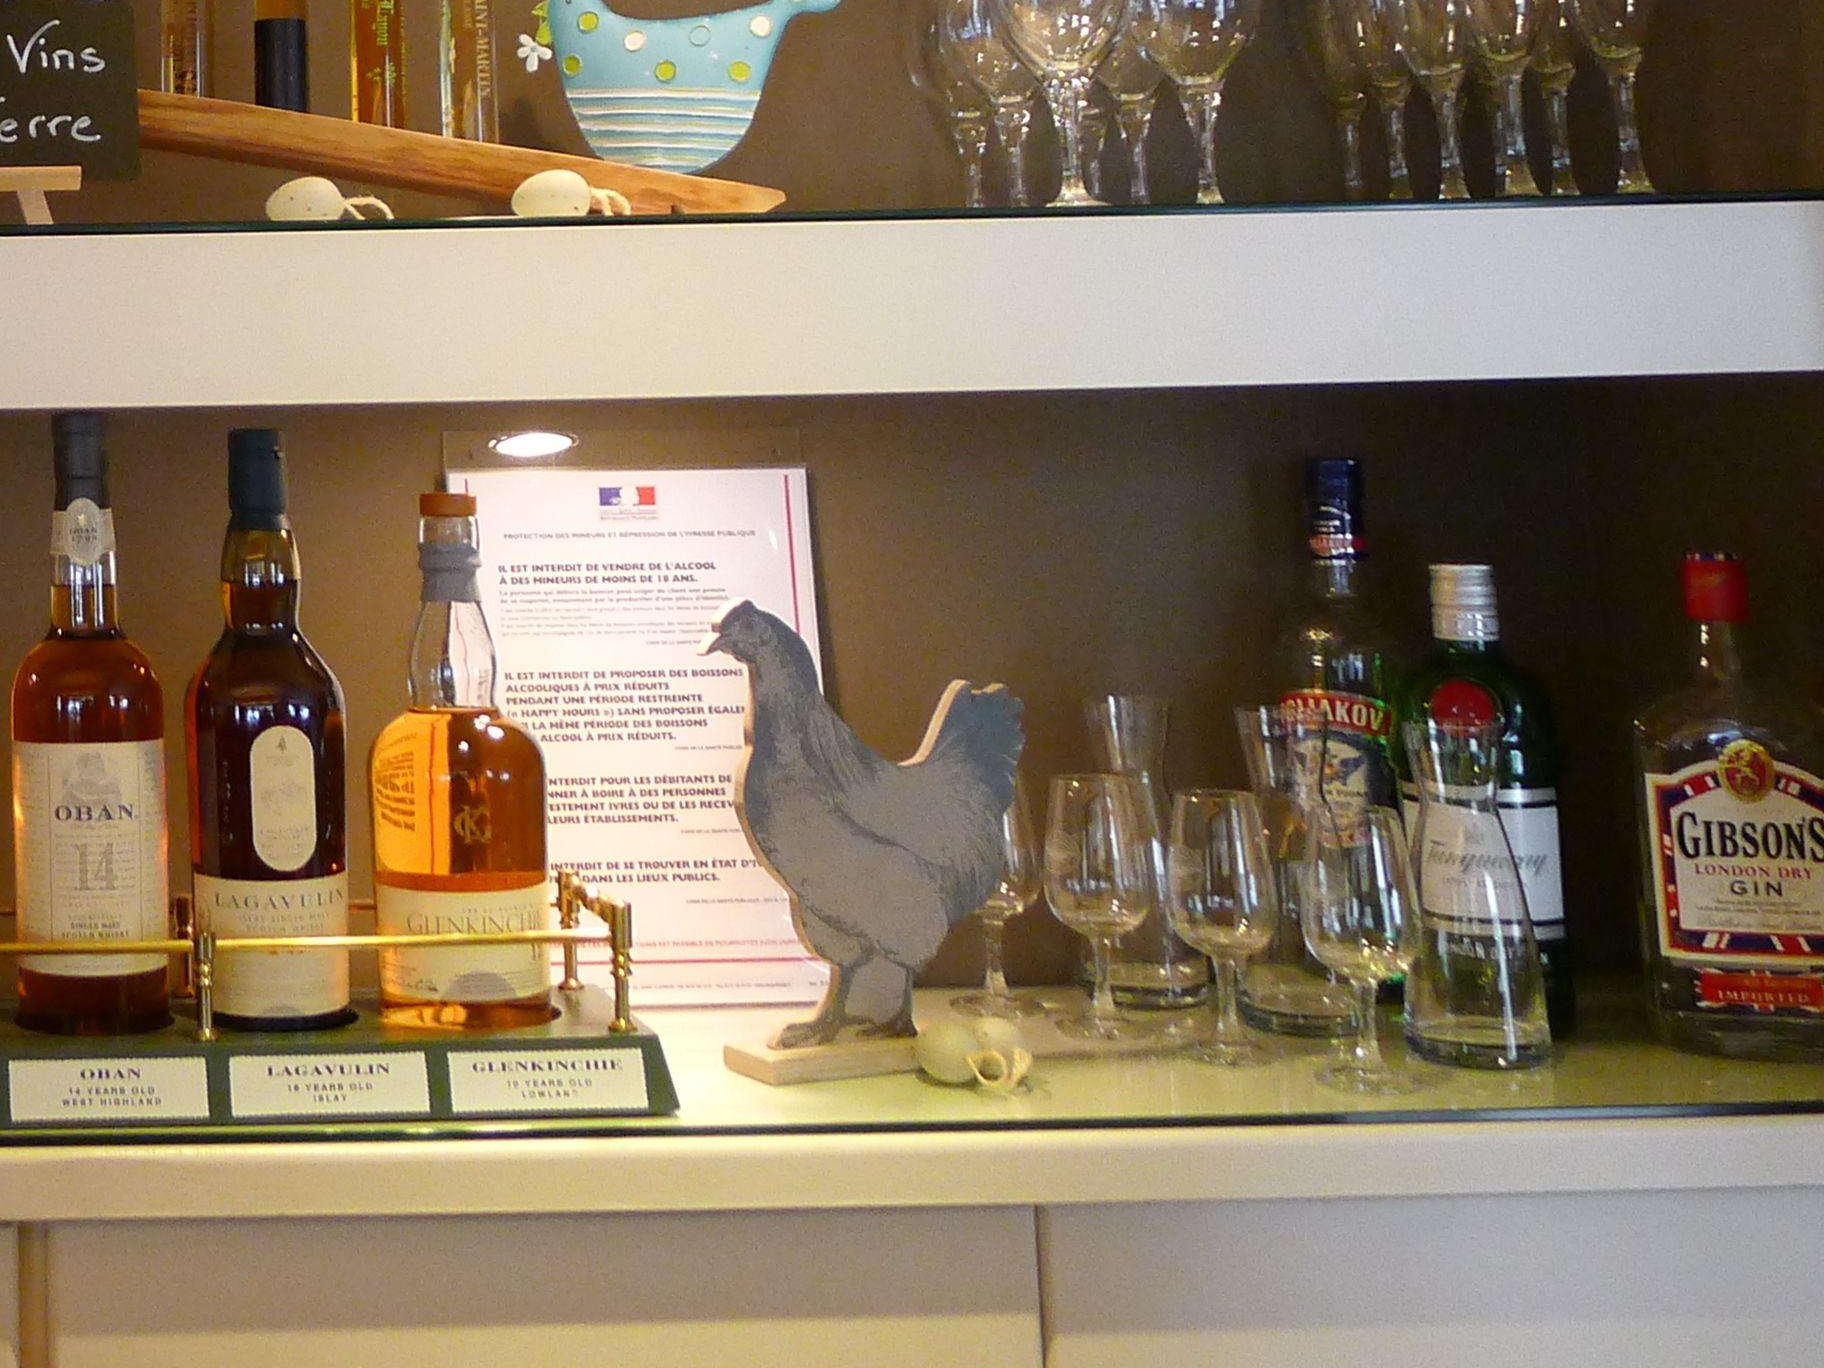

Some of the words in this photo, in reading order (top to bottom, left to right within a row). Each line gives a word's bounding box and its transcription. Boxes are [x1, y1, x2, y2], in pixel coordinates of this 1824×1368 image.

[7, 19, 106, 74] Vins
[498, 565, 508, 573] IL
[511, 564, 528, 573] EST
[532, 563, 582, 572] INTERDIT
[586, 563, 599, 572] DE
[602, 563, 645, 572] VENDRE
[649, 562, 662, 571] DE
[665, 561, 717, 571] L'ALCOOL
[511, 576, 530, 585] DES
[533, 575, 581, 585] MINEURS
[585, 575, 598, 584] DE
[602, 574, 637, 584] MOINS
[640, 574, 653, 583] DE
[672, 574, 698, 583] ANS.
[504, 672, 514, 681] IL
[517, 671, 534, 680] EST
[538, 670, 589, 680] INTERDIT
[593, 670, 606, 679] DE
[610, 669, 666, 679] PROPOSER
[669, 669, 688, 678] DES
[691, 668, 744, 678] BOISSONS
[505, 683, 580, 694] ALCOOLIQUES
[594, 682, 621, 692] PRIX
[506, 696, 560, 705] PENDANT
[563, 695, 586, 704] UNE
[638, 693, 703, 703] RESTREINTE
[521, 708, 559, 718] HAPPY
[563, 708, 600, 718] HOURS
[617, 707, 646, 717] SANS
[649, 706, 705, 716] PROPOSER
[532, 721, 547, 731] LA
[633, 719, 652, 728] DES
[656, 718, 708, 728] BOISSONS
[540, 733, 583, 743] ALCOOL
[597, 733, 624, 742] PRIX
[549, 777, 596, 786] NTERDIT
[600, 776, 631, 785] POUR
[635, 775, 651, 784] LES
[719, 774, 732, 784] DE
[592, 789, 625, 798] BOIRE
[639, 789, 659, 797] DES
[663, 787, 727, 797] PERSONNES
[609, 801, 640, 811] IVRES
[643, 801, 659, 810] OU
[662, 800, 676, 810] DE
[679, 800, 697, 809] LES
[699, 799, 735, 809] RECEV
[54, 804, 135, 822] OBAN
[1677, 811, 1824, 865] GIBSON'S
[75, 841, 120, 891] 14
[550, 861, 603, 871] INTERDIT
[606, 861, 619, 870] DE
[623, 861, 635, 870] SE
[638, 860, 690, 870] TROUVER
[693, 859, 709, 869] EN
[1694, 863, 1771, 878] LONDON
[1778, 864, 1814, 880] DRY
[583, 874, 613, 884] DANS
[617, 873, 634, 883] LES
[637, 873, 668, 883] LIEUX
[1730, 880, 1784, 897] GIN
[266, 1062, 390, 1076] LAGAVULIN
[472, 1058, 624, 1073] GLENKINCHIE
[79, 1068, 142, 1080] OBAN
[305, 1082, 345, 1092] YEARS
[349, 1081, 374, 1091] OLD
[525, 1078, 564, 1088] YEARS
[568, 1077, 593, 1087] OLD
[86, 1086, 126, 1096] YEARS
[130, 1085, 156, 1095] OLD
[61, 1097, 94, 1107] WEST
[99, 1096, 162, 1106] HIGHLAND
